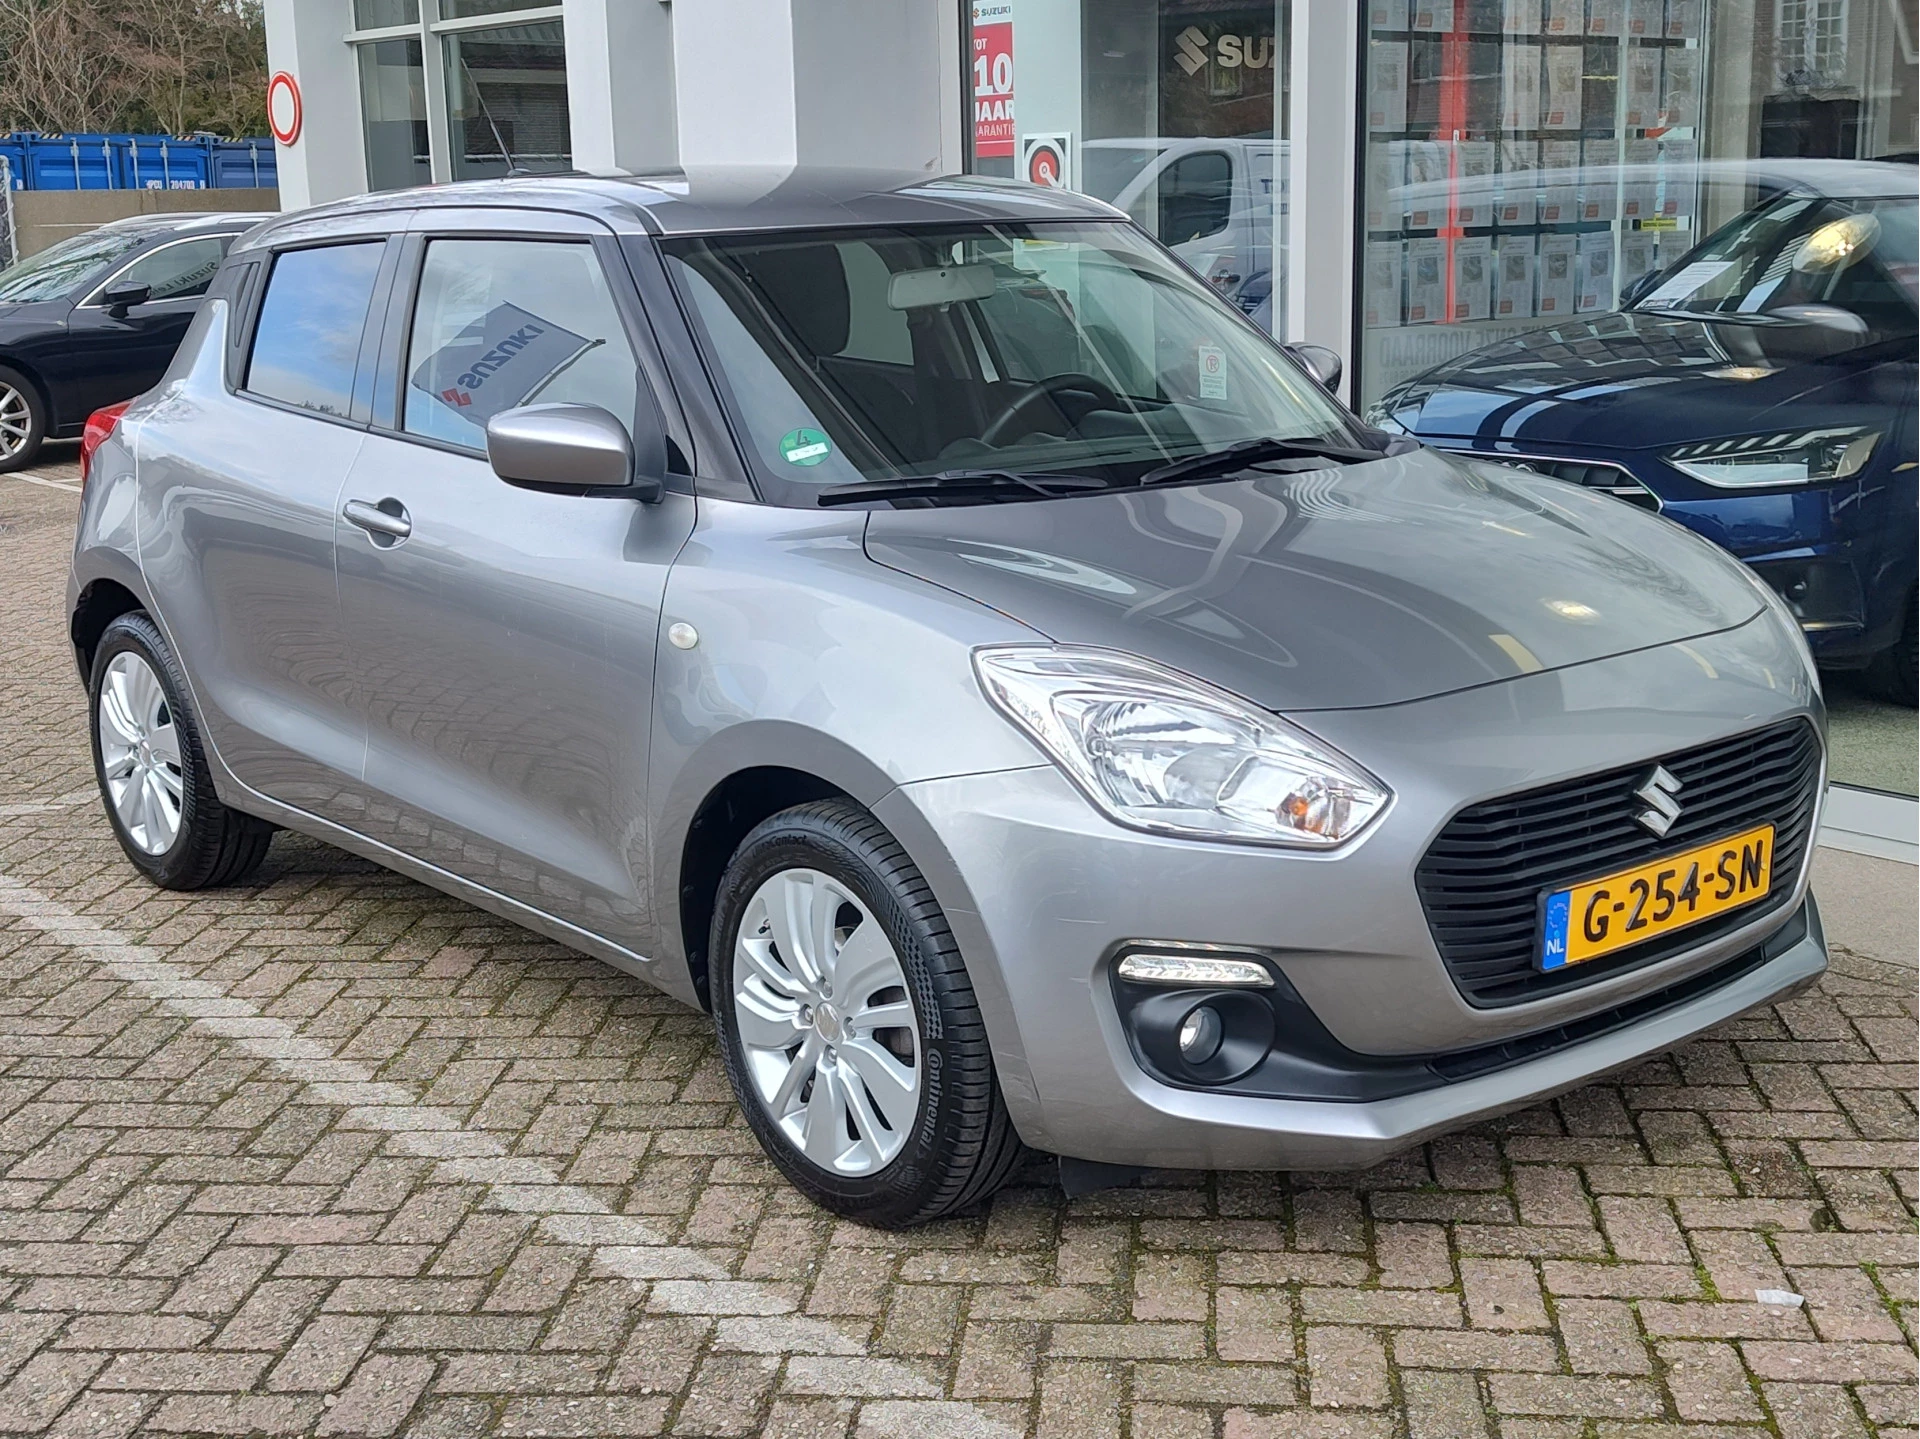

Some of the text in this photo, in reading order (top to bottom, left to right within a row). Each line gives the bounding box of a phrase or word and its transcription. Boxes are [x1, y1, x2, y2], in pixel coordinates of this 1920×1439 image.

[981, 6, 1011, 17] SUZUKI
[1217, 34, 1274, 69] SU
[974, 53, 1013, 97] 10
[1584, 839, 1763, 943] G-254-SN
[1546, 937, 1564, 957] NL
[920, 1047, 944, 1151] Continental
